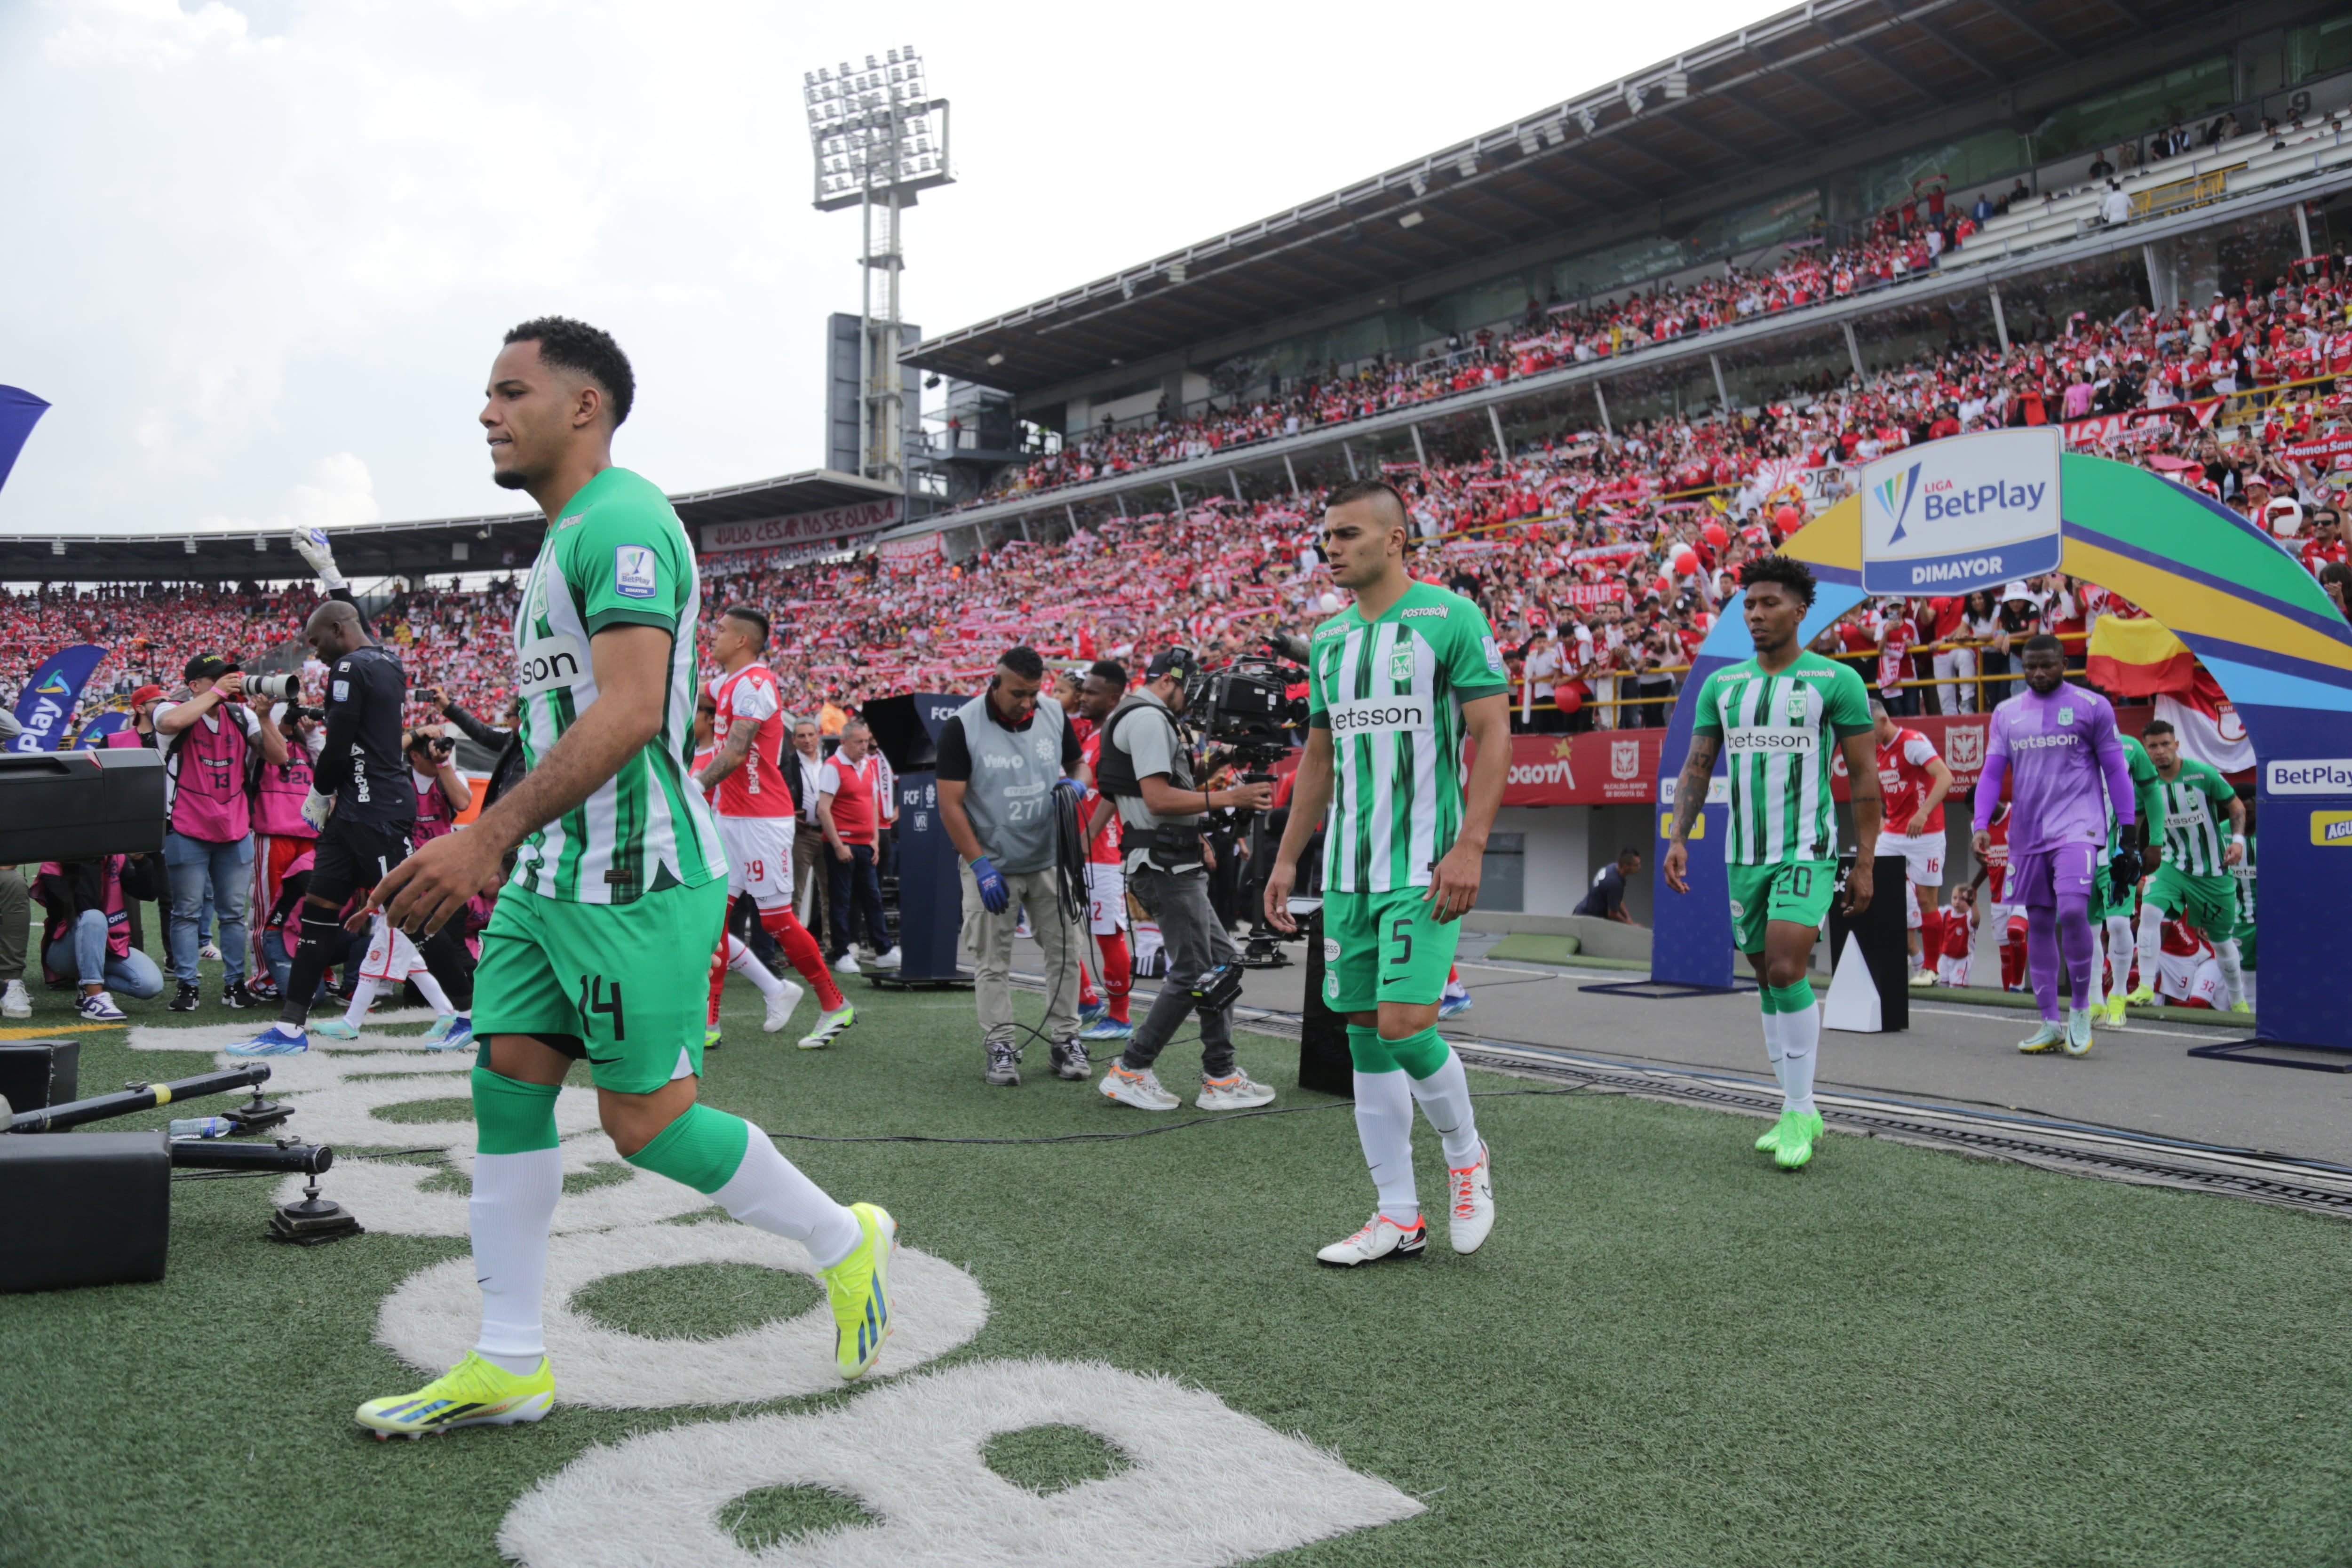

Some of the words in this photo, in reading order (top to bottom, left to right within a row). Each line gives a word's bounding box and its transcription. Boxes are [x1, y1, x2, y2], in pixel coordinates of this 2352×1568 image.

[2291, 91, 2311, 114] 9
[2287, 444, 2328, 456] Somos
[1924, 479, 1953, 493] LIGA
[1925, 479, 2046, 522] BetPlay
[715, 528, 752, 545] JULIO
[755, 518, 799, 541] CESAR
[803, 517, 822, 536] NO
[826, 511, 843, 532] SE
[622, 574, 650, 585] BetPlay
[1912, 556, 2002, 585] DIMAYOR
[519, 652, 579, 685] son
[17, 696, 63, 753] Play
[1728, 732, 1811, 748] betsson
[2010, 734, 2079, 751] betsson
[354, 757, 371, 803] BetPlay
[746, 752, 761, 795] BetPlay
[904, 790, 920, 805] FCF
[1009, 796, 1044, 821] 277
[1107, 815, 1117, 847] BetP
[2164, 812, 2205, 827] tsson
[1927, 857, 1939, 873] 16
[2085, 849, 2091, 875] 1
[1772, 865, 1812, 899] 20
[2202, 902, 2222, 921] 17
[1390, 918, 1413, 965] 5
[2178, 976, 2188, 988] 3
[2200, 979, 2215, 993] 32
[578, 974, 625, 1041] 14
